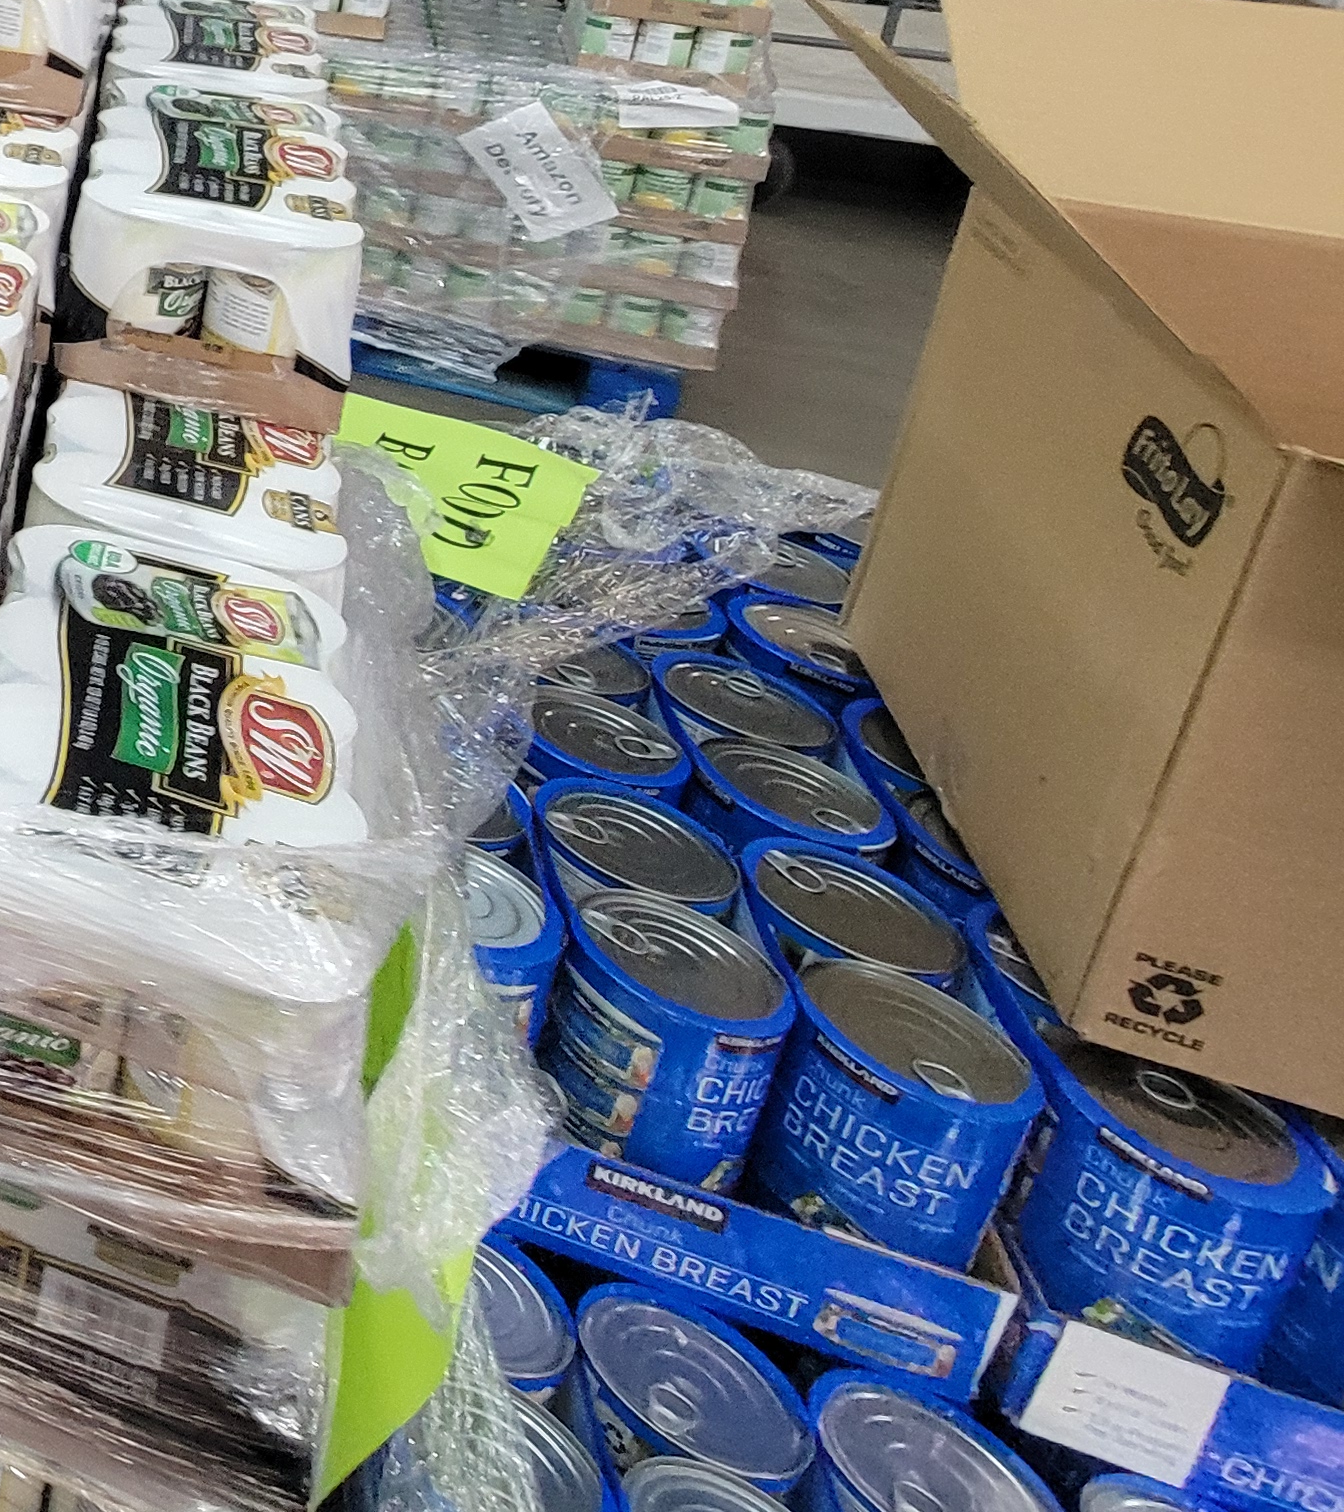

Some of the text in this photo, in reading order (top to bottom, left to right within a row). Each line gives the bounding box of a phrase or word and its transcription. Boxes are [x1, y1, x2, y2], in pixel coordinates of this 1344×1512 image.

[516, 129, 582, 207] Amazon
[217, 420, 240, 459] BEANS
[290, 492, 314, 530] CANS
[431, 453, 541, 552] FOOD
[152, 579, 193, 632] Organic
[226, 598, 279, 639] S&W
[116, 651, 180, 758] Organic
[182, 662, 220, 782] BLACK BEANS
[248, 699, 325, 796] S&W
[1134, 951, 1225, 987] PLEASE
[816, 1033, 902, 1103] KIRKLAND
[1103, 1011, 1207, 1052] RECYCLE
[784, 1113, 956, 1217] BREAST
[793, 1073, 974, 1190] CHICKEN
[594, 1161, 726, 1225] KIRKLAND
[607, 1203, 685, 1244] Chunk
[1078, 1171, 1290, 1281] CHICKEN
[514, 1196, 811, 1322] HICKEN BREAST
[1064, 1202, 1265, 1312] BREAST
